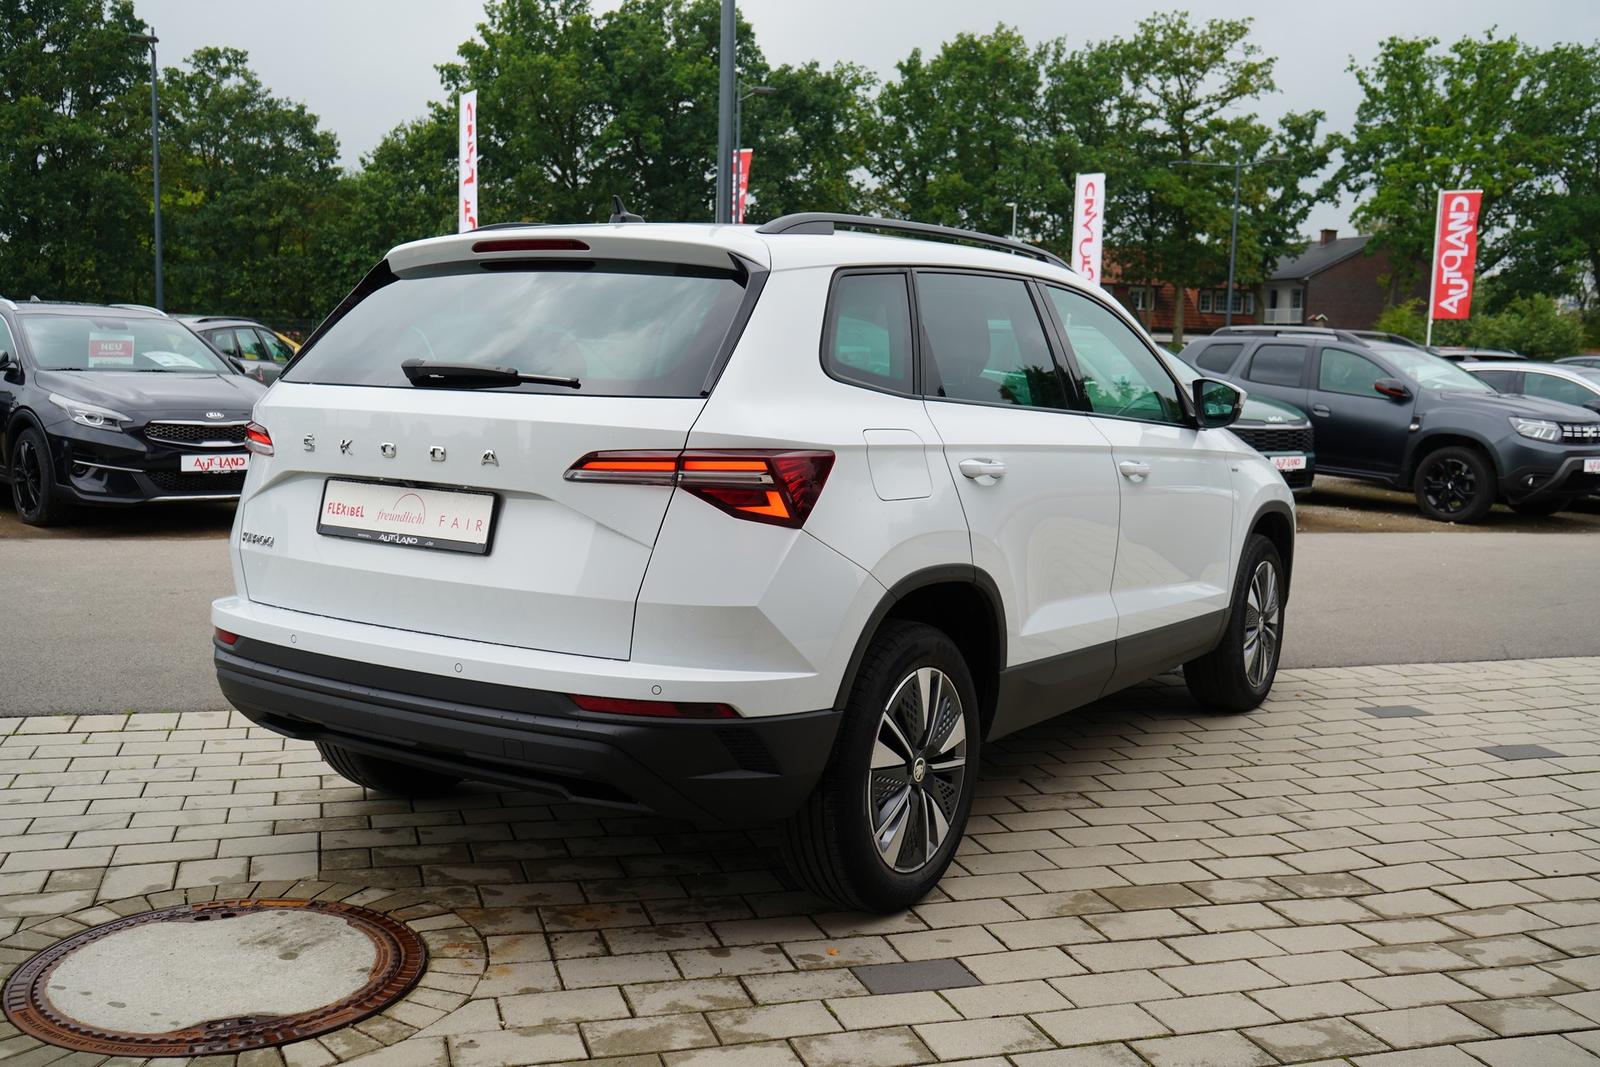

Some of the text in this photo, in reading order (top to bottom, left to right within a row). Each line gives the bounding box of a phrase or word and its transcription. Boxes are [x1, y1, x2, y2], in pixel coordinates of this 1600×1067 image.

[1079, 181, 1097, 281] UTOLAND
[1438, 196, 1473, 314] AUTOLAND
[101, 343, 123, 351] NEU
[194, 457, 246, 472] AUTOLAND
[327, 502, 483, 532] FLEXIBEL freundlich FAIR
[379, 533, 418, 545] AUTOLAND
